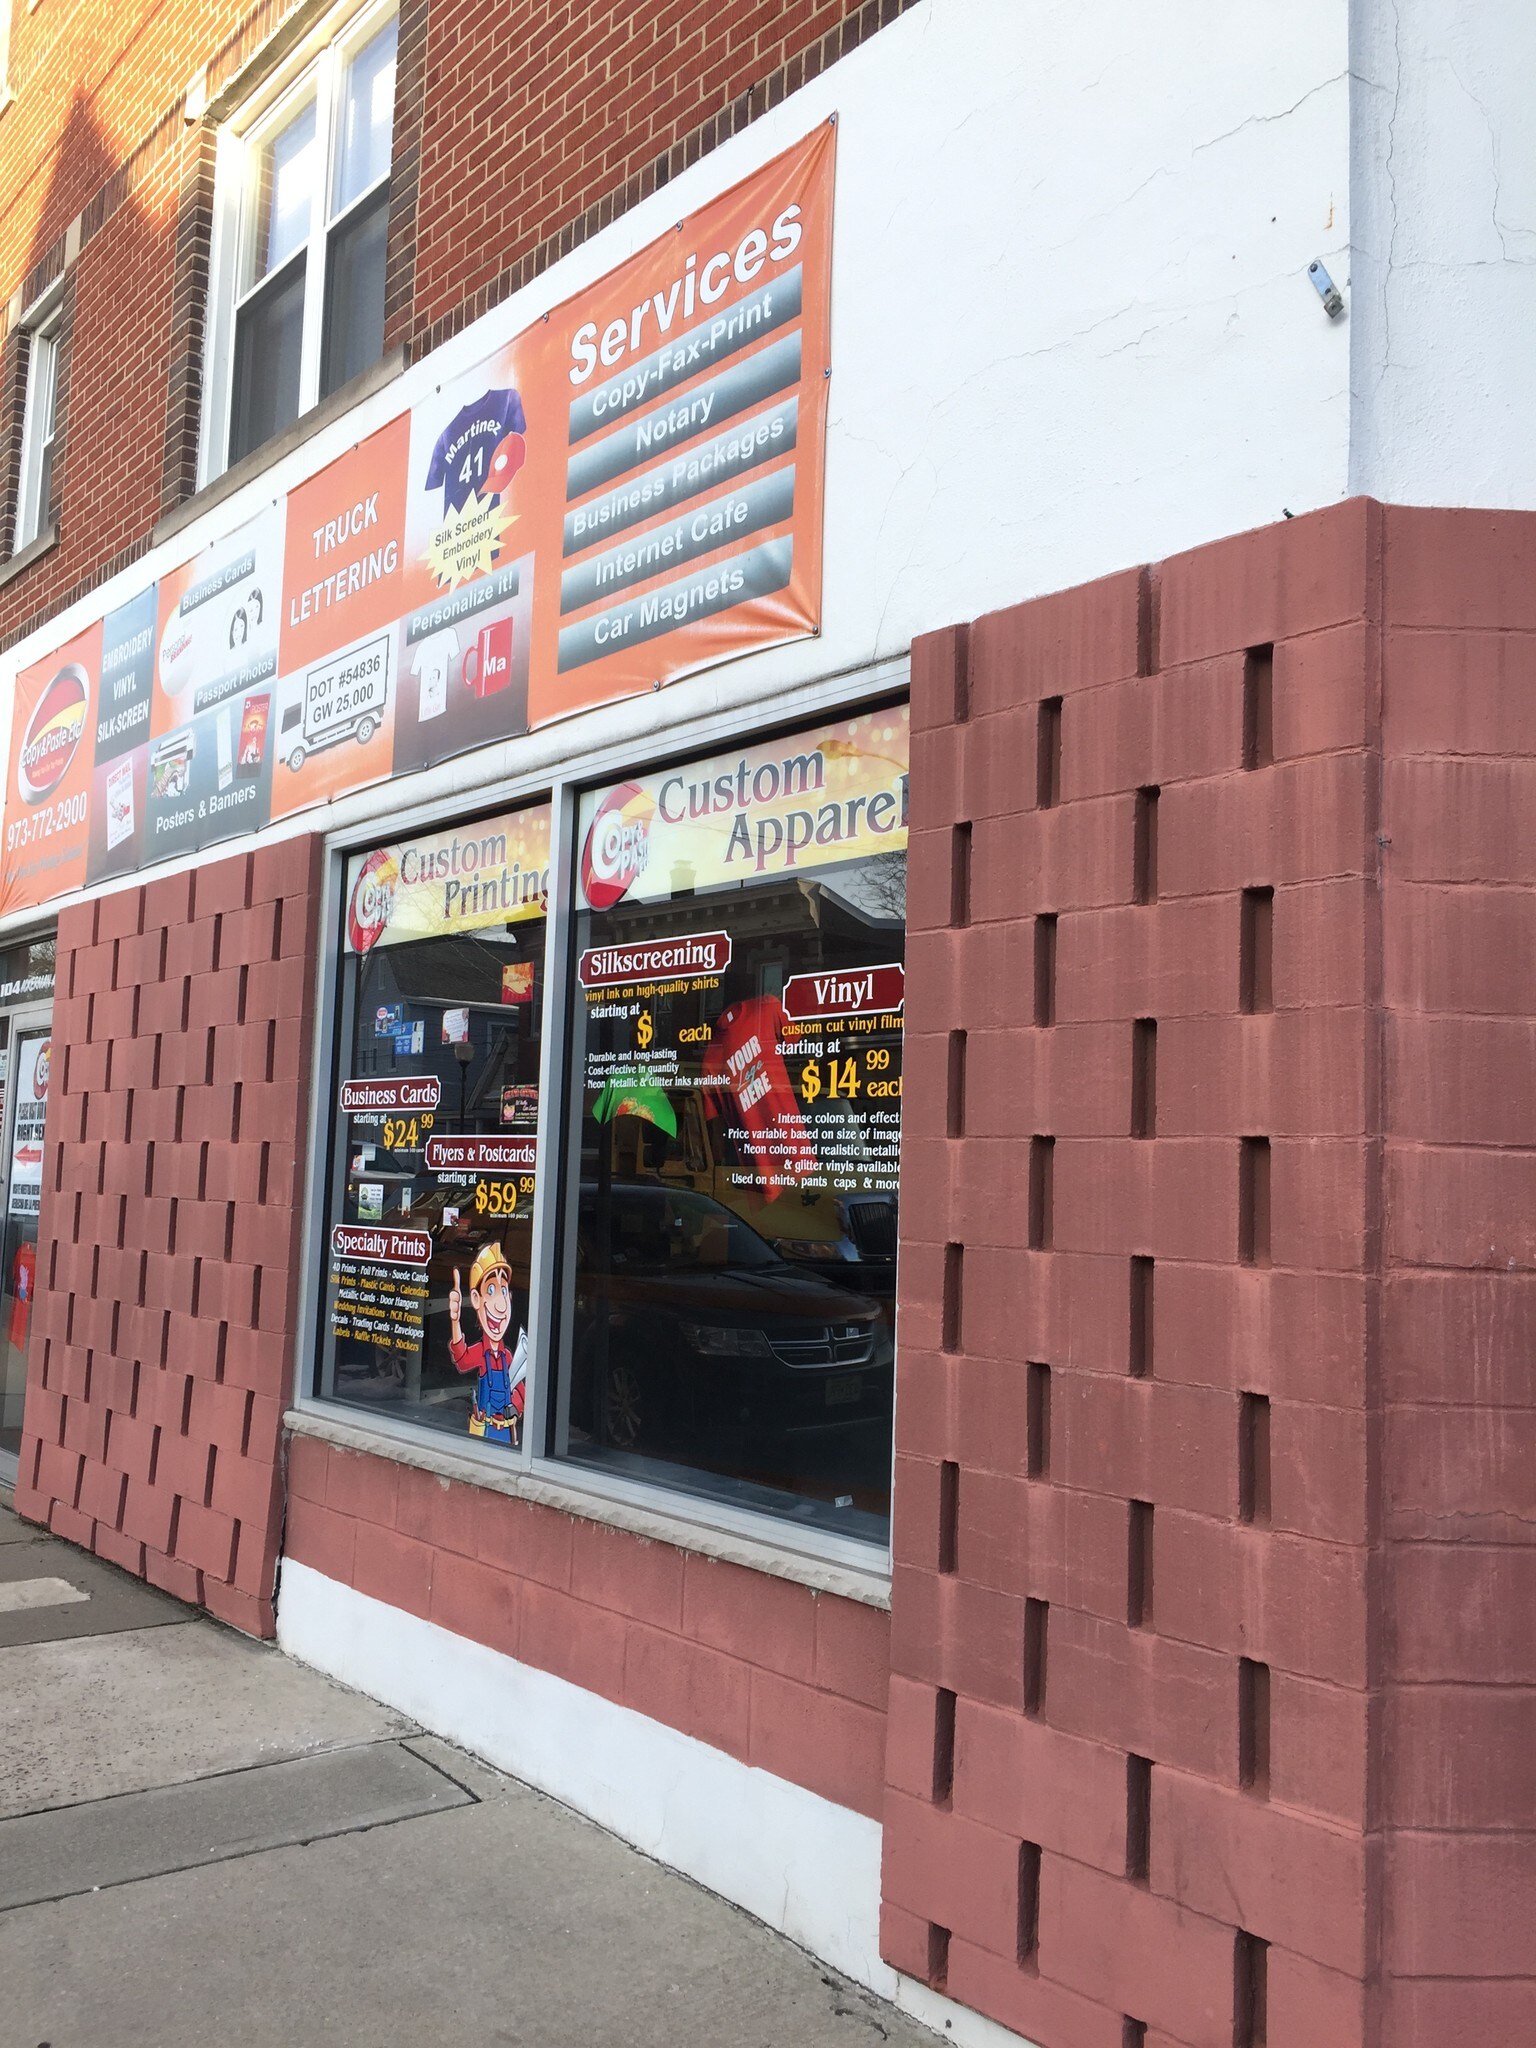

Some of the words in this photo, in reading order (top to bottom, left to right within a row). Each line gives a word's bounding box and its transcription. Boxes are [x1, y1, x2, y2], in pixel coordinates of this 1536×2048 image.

[569, 203, 802, 385] Services
[592, 293, 772, 417] Copy-Fax-Print
[636, 391, 715, 451] Notary
[445, 419, 501, 464] Martinez
[459, 447, 484, 484] 41
[573, 476, 665, 537] Business
[672, 417, 784, 488] Packages
[312, 491, 380, 559] TRUCK
[435, 529, 453, 547] Silk
[455, 511, 489, 536] Screen
[442, 527, 493, 560] Embroidery
[456, 549, 480, 572] Vinyl
[596, 527, 683, 586] Internet
[691, 501, 749, 543] Cafe
[182, 577, 222, 610] Business
[225, 557, 253, 583] Cards
[289, 540, 398, 628] LETTERING
[411, 584, 494, 636] Personalize
[498, 570, 513, 595] it!
[594, 610, 633, 644] Car
[640, 567, 745, 628] Magnets
[102, 625, 154, 673] EMBROIDERY
[483, 656, 506, 677] Ma
[113, 671, 136, 700] VINYL
[196, 675, 238, 706] Passport
[239, 658, 274, 685] Photos
[309, 675, 333, 702] DOT
[338, 655, 381, 690] #54836
[97, 699, 150, 743] SILK-SCREEN
[312, 700, 333, 724] GW
[336, 682, 374, 714] 25,000
[658, 750, 825, 825] Custom
[7, 790, 87, 852] 973-772-2900
[156, 808, 195, 834] Posters
[198, 800, 207, 819] &
[209, 785, 256, 815] Banners
[723, 773, 909, 872] Apparel
[401, 832, 507, 885] Custom
[590, 940, 717, 976] Silkscreening
[0, 980, 21, 997] 104
[585, 988, 604, 1003] vinyl
[606, 987, 620, 999] ink
[623, 988, 634, 998] on
[636, 979, 689, 999] high-quality
[692, 976, 719, 991] shirts
[813, 973, 874, 1009] Vinyl
[590, 1003, 628, 1019] starting
[629, 1002, 641, 1015] at
[781, 1021, 822, 1036] custom
[826, 1020, 845, 1033] cut
[849, 1016, 877, 1033] vinyl
[880, 1015, 904, 1030] film
[637, 1010, 653, 1049] $
[679, 1023, 712, 1042] each
[588, 1052, 616, 1062] Durable
[617, 1050, 632, 1061] and
[634, 1049, 677, 1062] long-lasting
[726, 1035, 762, 1077] YOUR
[774, 1039, 824, 1058] starting
[827, 1038, 841, 1053] at
[866, 1049, 890, 1071] 99
[587, 1079, 606, 1089] Neon
[609, 1076, 638, 1088] Metallic
[639, 1076, 647, 1087] &
[649, 1076, 673, 1087] Glitter
[674, 1076, 692, 1086] inks
[693, 1074, 731, 1085] available
[588, 1065, 637, 1076] Cost-effective
[638, 1064, 646, 1074] in
[647, 1062, 680, 1075] quantity
[344, 1086, 397, 1106] Business
[401, 1083, 438, 1104] Cards
[739, 1070, 772, 1113] HERE
[353, 1113, 379, 1127] starting
[380, 1113, 387, 1124] at
[383, 1117, 419, 1151] $24
[421, 1113, 434, 1129] 99
[728, 1128, 750, 1139] Price
[752, 1128, 787, 1139] variable
[790, 1127, 819, 1139] based
[821, 1130, 834, 1139] on
[836, 1128, 857, 1140] size
[859, 1127, 871, 1140] of
[778, 1113, 812, 1124] Intense
[815, 1112, 845, 1124] colors
[847, 1112, 867, 1123] and
[433, 1144, 464, 1165] Flyers
[467, 1147, 475, 1161] &
[479, 1144, 535, 1163] Postcards
[743, 1144, 767, 1154] Neon
[769, 1144, 797, 1155] colors
[800, 1144, 818, 1155] and
[821, 1144, 860, 1156] realistic
[784, 1159, 793, 1170] &
[795, 1160, 824, 1173] glitter
[826, 1160, 854, 1174] vinyls
[437, 1171, 467, 1186] starting
[468, 1172, 477, 1184] at
[475, 1179, 517, 1214] $59
[520, 1176, 535, 1193] 99
[732, 1173, 753, 1184] Used
[755, 1176, 767, 1184] on
[769, 1174, 798, 1187] shirts,
[801, 1175, 828, 1189] pants
[833, 1178, 857, 1191] caps
[863, 1177, 873, 1188] &
[336, 1231, 388, 1258] Specialty
[391, 1235, 426, 1257] Prints
[333, 1262, 340, 1271] 4D
[341, 1263, 356, 1274] Prints
[360, 1265, 371, 1275] Foil
[371, 1266, 388, 1278] Prints
[392, 1269, 410, 1280] Suede
[411, 1272, 429, 1283] Cards
[341, 1275, 356, 1287] Prints
[360, 1278, 378, 1290] Plastic
[379, 1281, 395, 1292] Cards
[400, 1284, 430, 1298] Calendars
[334, 1301, 356, 1315] Wedding
[357, 1304, 385, 1318] Invitations
[390, 1310, 402, 1320] NCR
[403, 1312, 422, 1324] Forms
[338, 1288, 359, 1300] Metallic
[360, 1291, 375, 1303] Cards
[380, 1294, 394, 1306] Door
[395, 1296, 419, 1310] Hangers
[331, 1312, 348, 1325] Decals
[353, 1316, 372, 1331] Trading
[373, 1320, 390, 1332] Cards
[394, 1323, 424, 1339] Envelopes
[333, 1326, 350, 1337] Labels
[354, 1330, 370, 1342] Raffle
[371, 1333, 391, 1346] Tickets
[395, 1338, 419, 1352] Stickers
